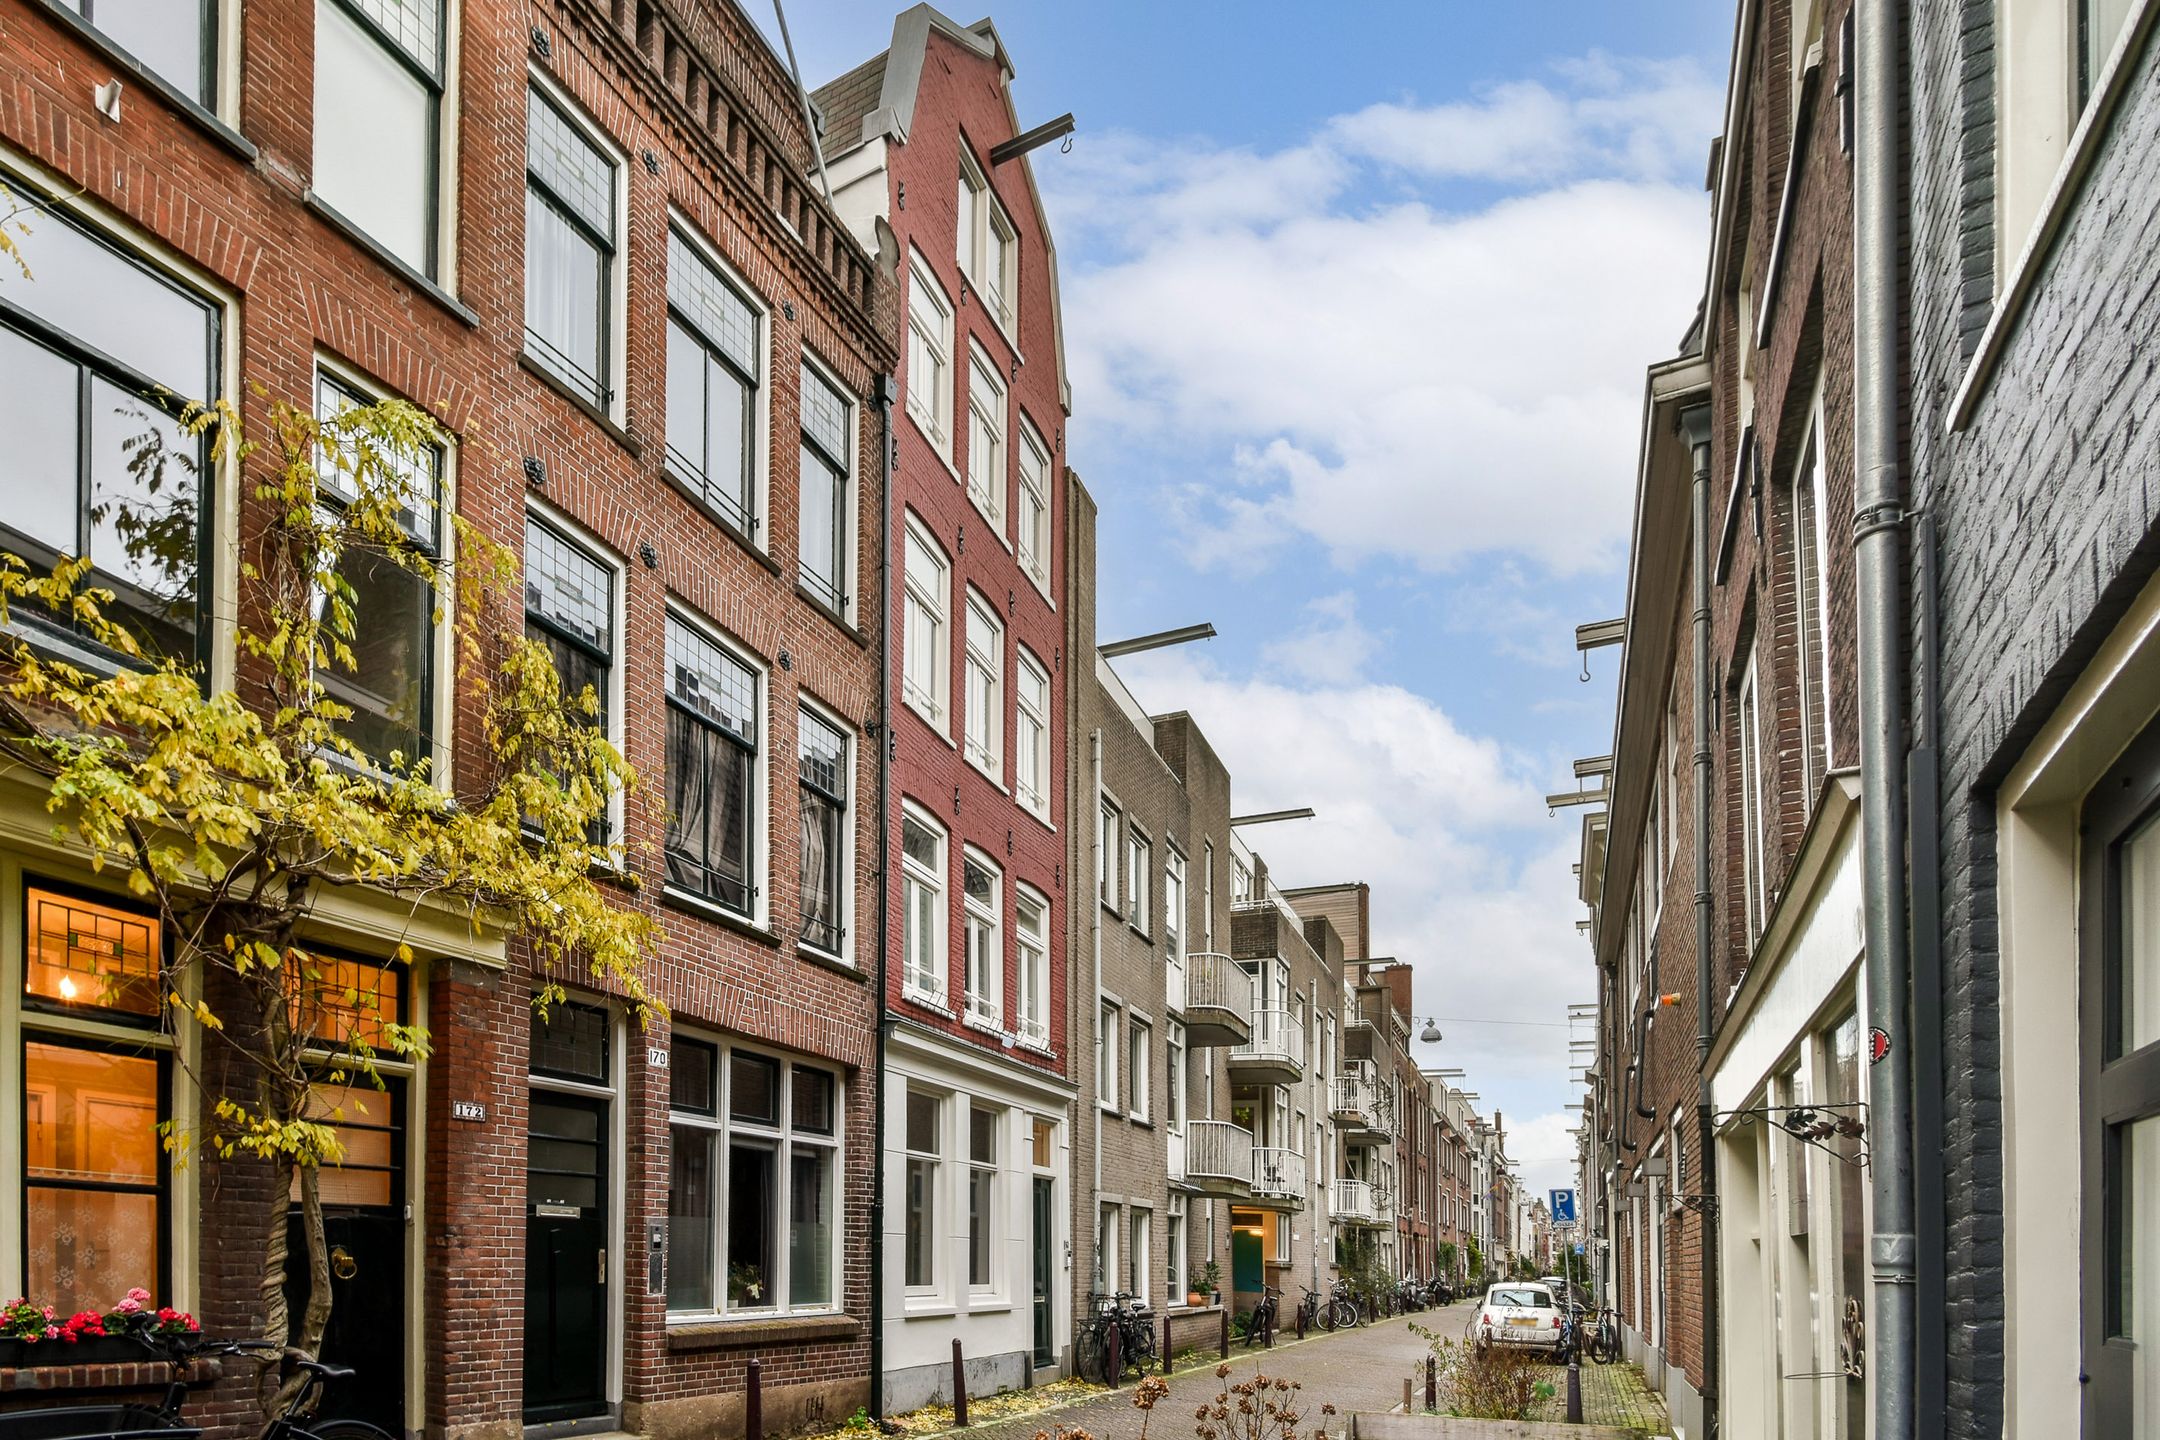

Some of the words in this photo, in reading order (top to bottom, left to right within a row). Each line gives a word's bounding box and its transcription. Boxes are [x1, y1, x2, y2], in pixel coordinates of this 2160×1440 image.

[650, 1050, 666, 1065] 170
[459, 1105, 482, 1117] 172
[1555, 1191, 1569, 1209] P
